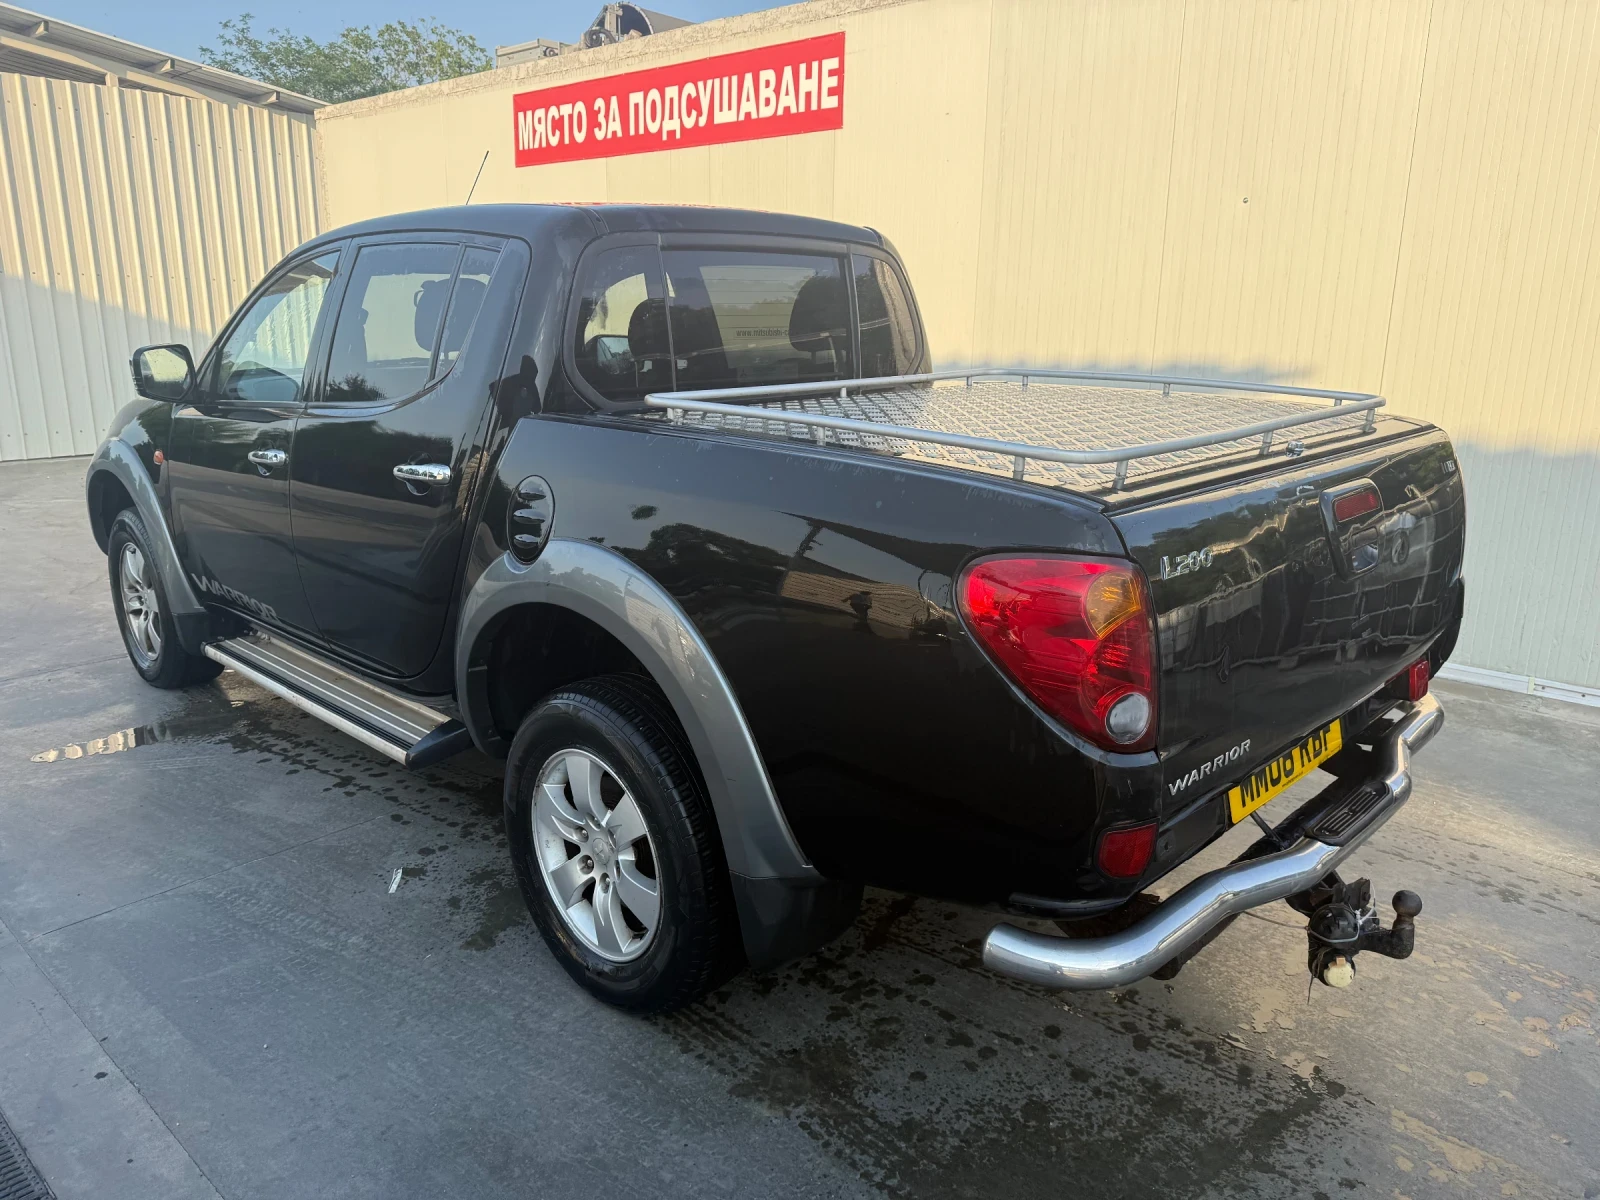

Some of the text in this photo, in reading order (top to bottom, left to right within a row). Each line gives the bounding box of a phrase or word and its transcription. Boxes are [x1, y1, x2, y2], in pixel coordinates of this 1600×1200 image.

[517, 56, 840, 150] МЯСТО ЗА ПОДСУШАВАНЕ
[1160, 547, 1213, 580] L200
[191, 573, 279, 622] WARRIOR
[1168, 738, 1251, 796] WARRIOR
